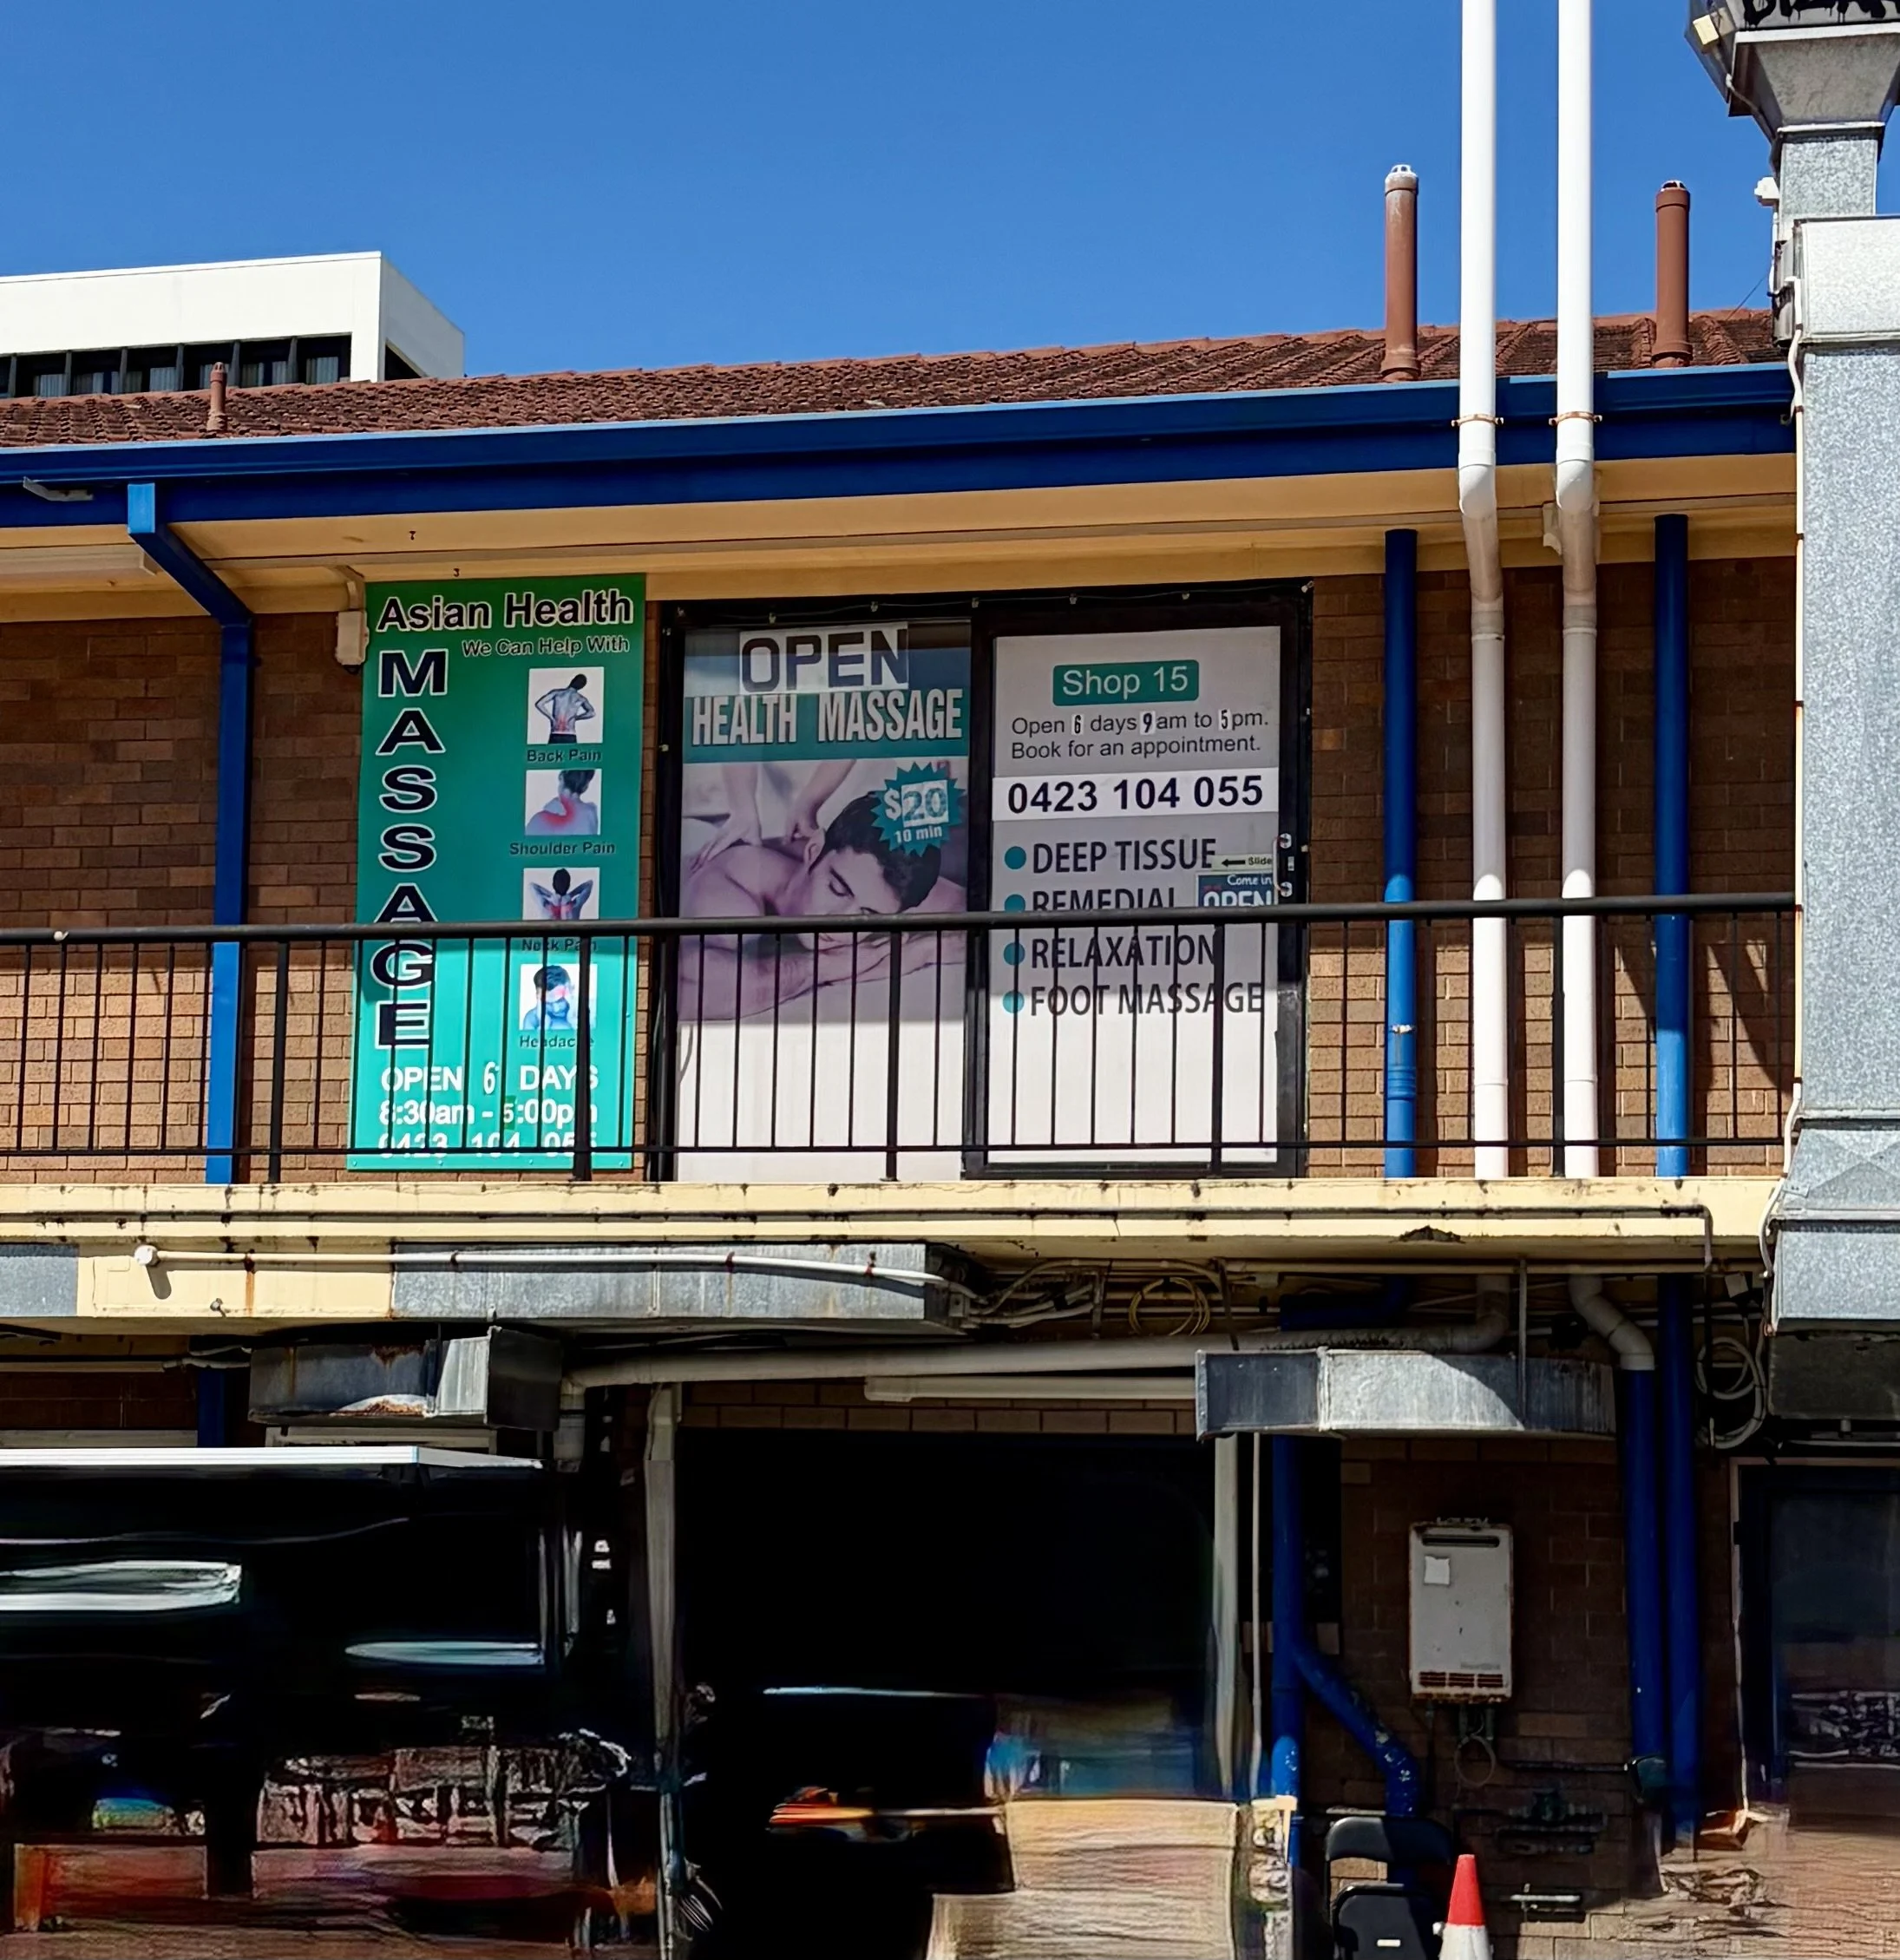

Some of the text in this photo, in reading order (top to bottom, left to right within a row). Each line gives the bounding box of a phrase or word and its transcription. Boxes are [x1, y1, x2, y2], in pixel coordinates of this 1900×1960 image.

[376, 588, 633, 632] Asian Health
[462, 636, 630, 658] We Can Help With
[741, 628, 907, 692] OPEN
[1063, 665, 1188, 699] Shop 15
[692, 688, 963, 745] HEALTH MASSAGE
[1012, 718, 1065, 737] Open
[1073, 715, 1082, 734] 6
[1091, 715, 1137, 737] days
[1143, 712, 1187, 733] 9am
[1195, 712, 1212, 729] to
[527, 749, 602, 763] Back Pain
[1012, 735, 1261, 759] Book for an appointment.
[884, 785, 948, 822] $20
[1007, 775, 1263, 814] 0423 104 055
[894, 825, 942, 844] 10 min
[370, 648, 449, 1050] MASSAGE
[509, 842, 616, 855] Shoulder Pain
[1032, 838, 1216, 873] DEEP TISSUE
[1248, 856, 1272, 866] Slide
[1227, 874, 1272, 885] Come in
[1203, 890, 1272, 907] OPEN
[521, 938, 560, 951] Nek
[1032, 934, 1217, 968] RELAXATION
[1031, 981, 1263, 1016] FOOT MASSAGE
[520, 1035, 594, 1048] Hedac
[381, 1065, 462, 1091] OPEN
[544, 1131, 597, 1157] 05
